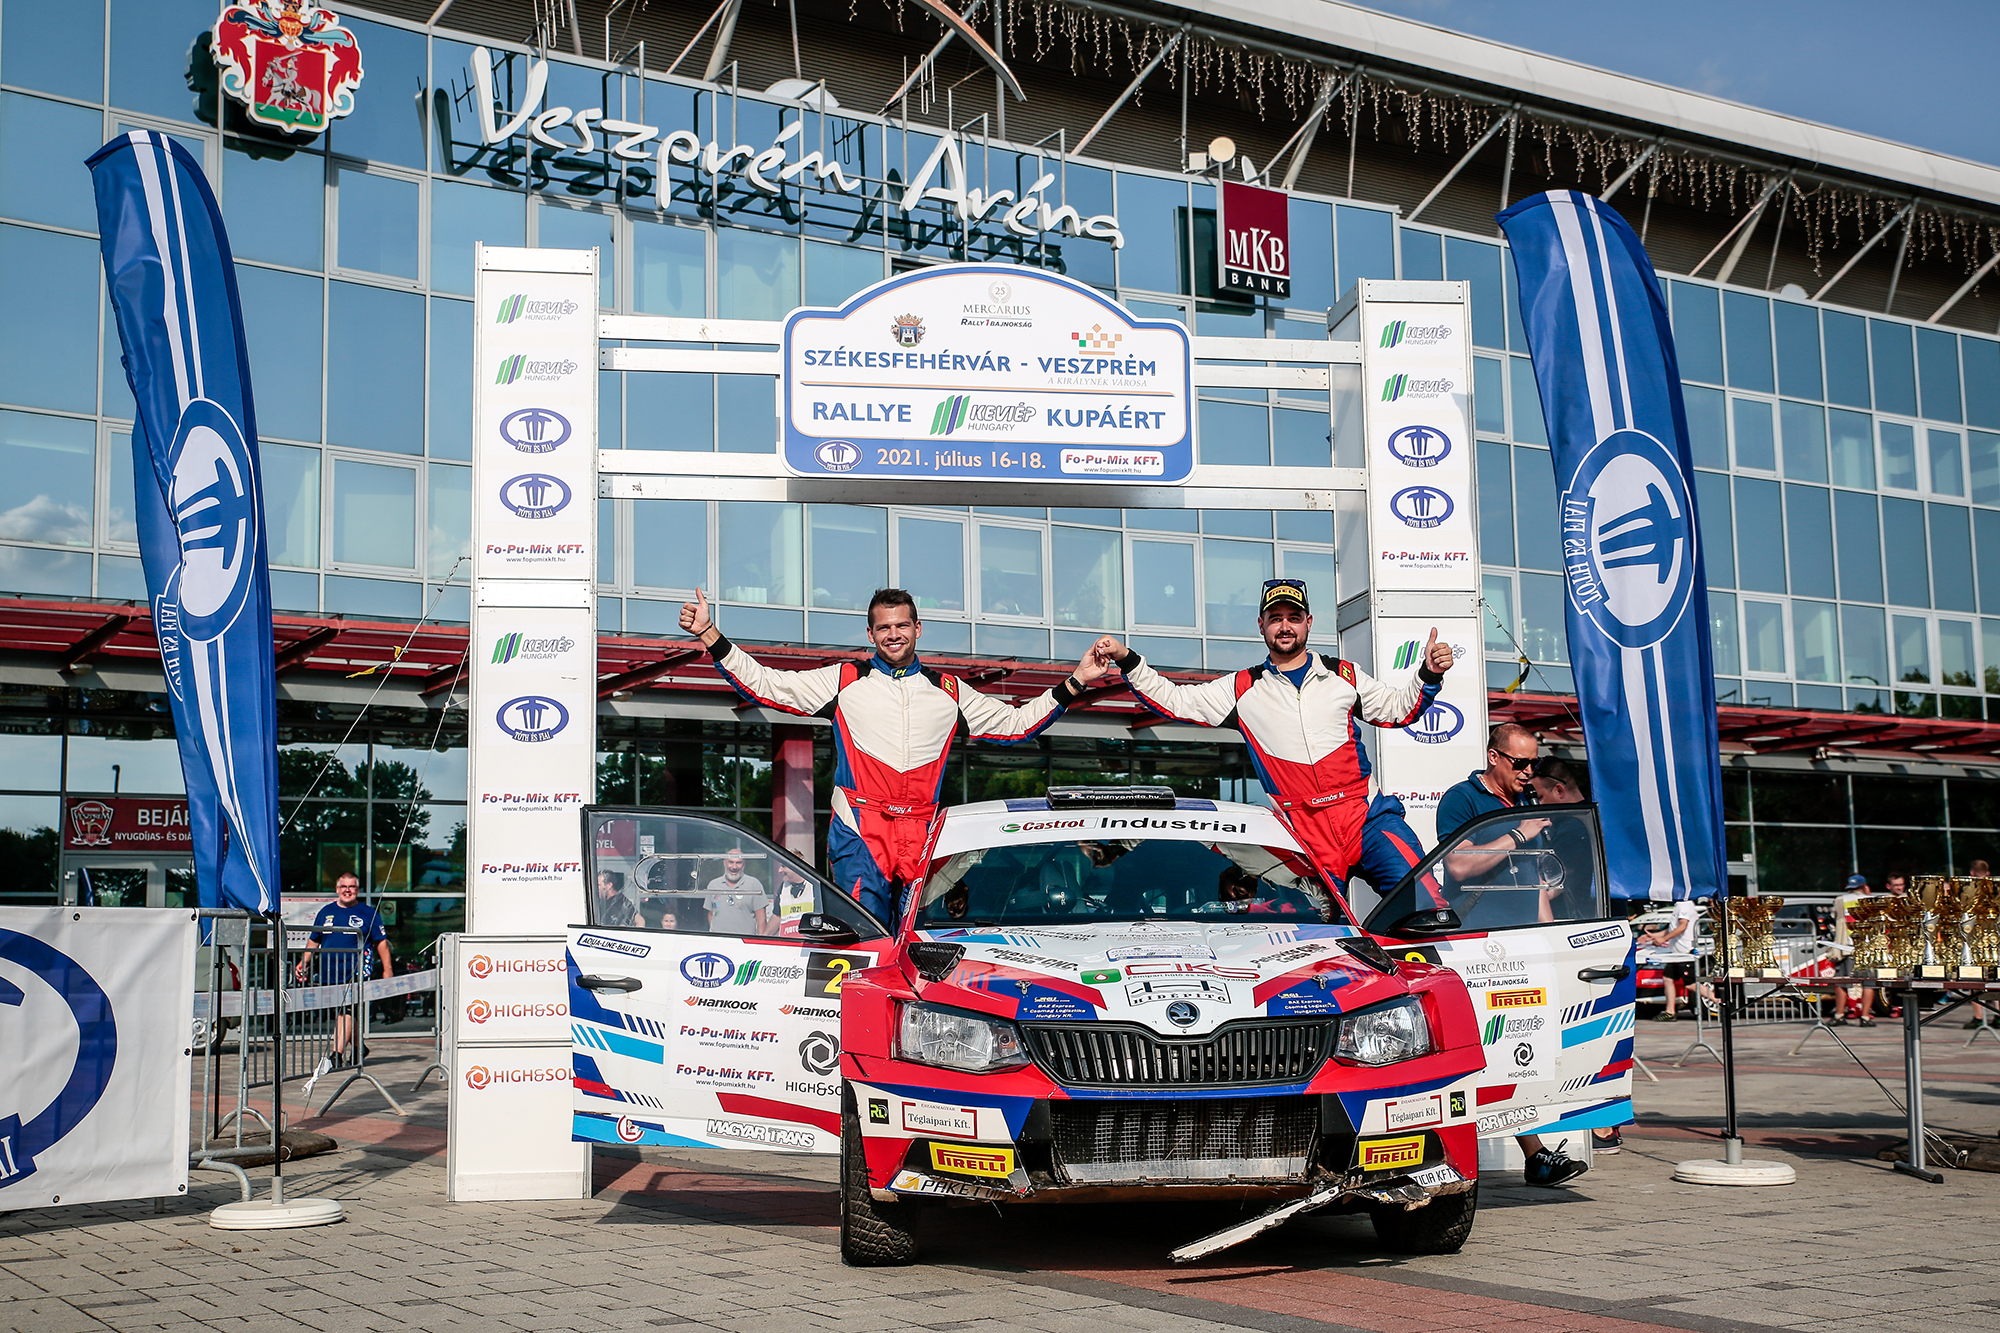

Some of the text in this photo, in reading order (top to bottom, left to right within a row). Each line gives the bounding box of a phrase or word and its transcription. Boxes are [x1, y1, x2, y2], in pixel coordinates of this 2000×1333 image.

[469, 45, 1124, 250] Veszprém Aréna
[1228, 227, 1286, 275] MKB
[1231, 272, 1285, 293] BANK
[995, 286, 1006, 296] 25
[526, 299, 578, 316] KEVIÉP
[963, 304, 1031, 315] MERCARIUS
[524, 314, 562, 322] HUNGARY
[1406, 325, 1452, 340] KEVIÉP
[526, 359, 578, 375] KEVIÉP
[804, 346, 1012, 372] SZÉKESFEHÉRVÁR
[1408, 378, 1454, 393] KEVIÉP
[1406, 392, 1440, 400] HUNGARY
[813, 401, 912, 424] RALLYE
[969, 402, 1036, 422] KEVIÉP
[1047, 405, 1166, 430] KUPÁÉRT
[968, 422, 1016, 432] HUNGARY
[877, 448, 1047, 470] 2021. július 16-18.
[1065, 454, 1160, 466] Fo-Pu-Mix KFT.
[485, 544, 585, 555] Fo-Pu-Mix KFT.
[1382, 551, 1469, 562] Fo-Pu-Mix KFT.
[522, 636, 575, 653] KEVIÉP
[482, 793, 582, 804] Fo-Pu-Mix KFT.
[1311, 794, 1338, 805] Csomós
[502, 805, 563, 813] www.fopumixkft.hu
[887, 804, 907, 814] Nagy
[1022, 816, 1247, 835] Castrol Industrial
[115, 831, 177, 841] NYUGDÍJAS- ÉS
[481, 862, 582, 874] Fo-Pu-Mix KFT.
[501, 875, 563, 883] www.fopumixkft.hu
[582, 937, 646, 955] AQUA-LINE-BAU KFT.
[496, 959, 568, 973] HIGH&SO
[760, 965, 804, 979] KEVIÉP
[1465, 961, 1526, 976] MERCARIUS
[823, 957, 851, 993] 2
[1491, 989, 1542, 1007] PIRELLI
[494, 1003, 567, 1017] HIGH&SO
[793, 1005, 842, 1018] HanKOO
[1505, 1015, 1545, 1032] KEVIÉP
[680, 1025, 779, 1043] Fo-Pu-Mix KFT.
[699, 1040, 759, 1051] www.fopumixkft.hu
[676, 1064, 775, 1082] Fo-Pu-Mix KFT.
[1507, 1070, 1539, 1079] HIGH&SOL
[695, 1079, 756, 1090] www.fopumixkft.hu
[785, 1081, 842, 1097] HIGH&SO
[907, 1113, 971, 1130] Téglaipari Kft.
[1390, 1105, 1438, 1124] Téglaipari Kft.
[1498, 1104, 1538, 1127] TRANS
[706, 1118, 816, 1148] MAGYAR TRANS
[936, 1148, 1006, 1172] PIRELLI
[1366, 1142, 1419, 1165] PIRELLI
[1413, 1168, 1456, 1186] TICIA KFT.
[921, 1180, 980, 1198] PAKET
